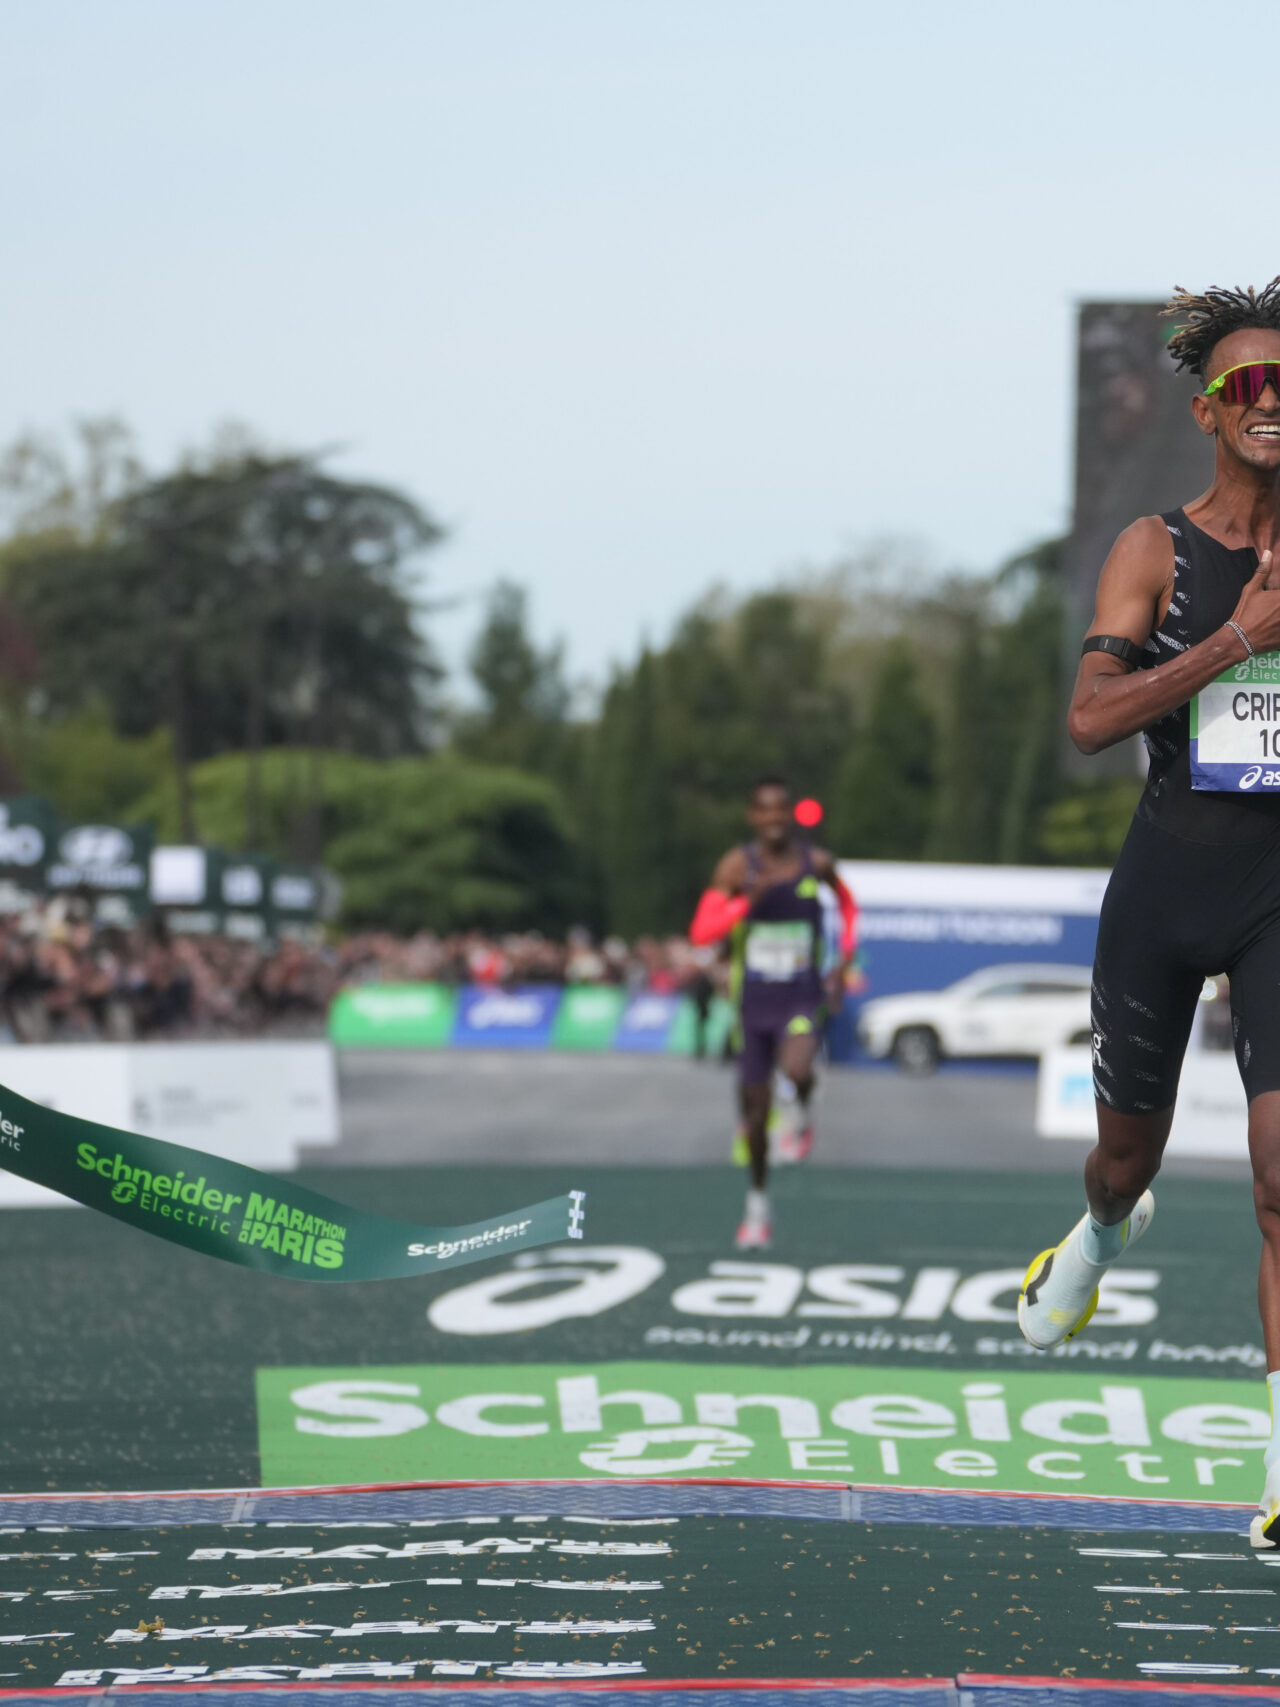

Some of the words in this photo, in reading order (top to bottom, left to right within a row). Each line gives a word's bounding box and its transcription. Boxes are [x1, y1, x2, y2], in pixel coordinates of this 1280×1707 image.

[76, 1142, 243, 1214] Schneider
[140, 1191, 231, 1236] Electric
[245, 1192, 347, 1241] MARATHON
[407, 1218, 532, 1257] Schneider
[248, 1221, 345, 1270] PARIS
[672, 1261, 1161, 1326] asics
